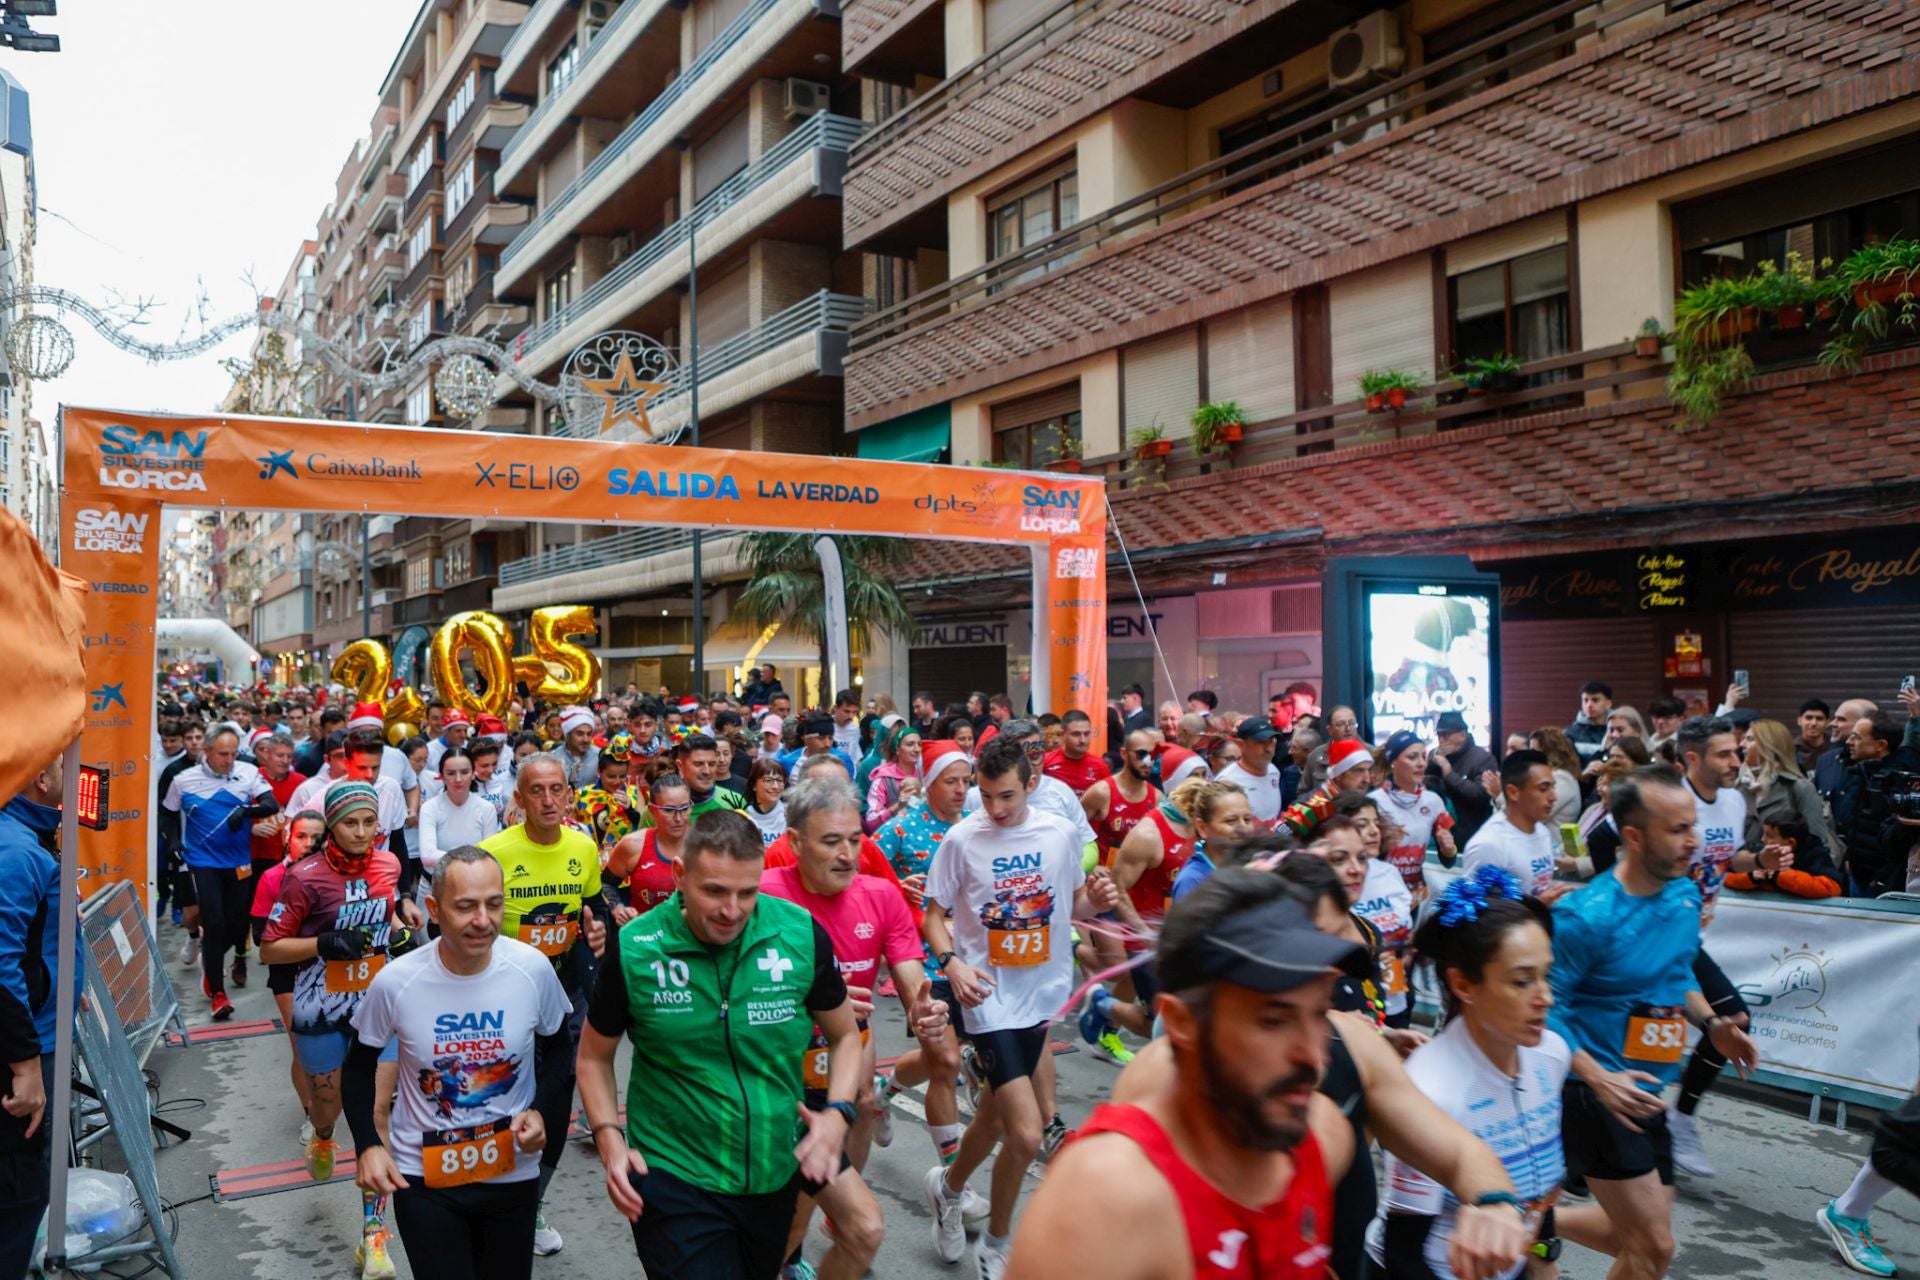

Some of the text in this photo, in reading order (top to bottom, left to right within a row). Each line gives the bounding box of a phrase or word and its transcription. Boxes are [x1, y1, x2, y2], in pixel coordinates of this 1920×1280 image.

[98, 425, 208, 458] SAN
[102, 456, 205, 471] SILVESTRE
[306, 453, 423, 479] CaixaBank
[99, 468, 208, 491] LORCA
[607, 468, 741, 501] SALIDA
[758, 480, 880, 505] LA VERDAD
[914, 493, 977, 513] dpts
[1023, 485, 1080, 509] SAN
[74, 509, 149, 533] SAN
[1020, 516, 1081, 533] LORCA
[74, 538, 144, 554] LORCA
[75, 530, 144, 542] SILVESTRE
[1057, 548, 1099, 564] SAN
[1788, 547, 1920, 593] Royal
[91, 582, 149, 594] VERDAD
[1501, 575, 1539, 607] yal
[1109, 613, 1163, 637] ENT
[85, 631, 128, 650] pts
[108, 808, 141, 821] RDAD
[991, 852, 1042, 873] SAN
[345, 879, 369, 902] LA
[509, 883, 557, 899] TRIATLÓN
[993, 873, 1044, 890] LORCA
[334, 897, 389, 931] HOYA
[1353, 896, 1392, 915] SAN
[529, 926, 568, 947] 540
[1001, 931, 1043, 955] 473
[345, 961, 370, 981] 18
[649, 958, 690, 989] 10
[653, 989, 693, 1004] AÑOS
[433, 1010, 505, 1034] SAN
[1751, 1010, 1839, 1033] yuntamientolorca
[435, 1030, 505, 1043] SILVESTRE
[1760, 1026, 1777, 1038] de
[1780, 1028, 1837, 1049] Deportes
[433, 1039, 506, 1056] LORCA
[465, 1052, 499, 1062] 2024
[440, 1139, 499, 1175] 896
